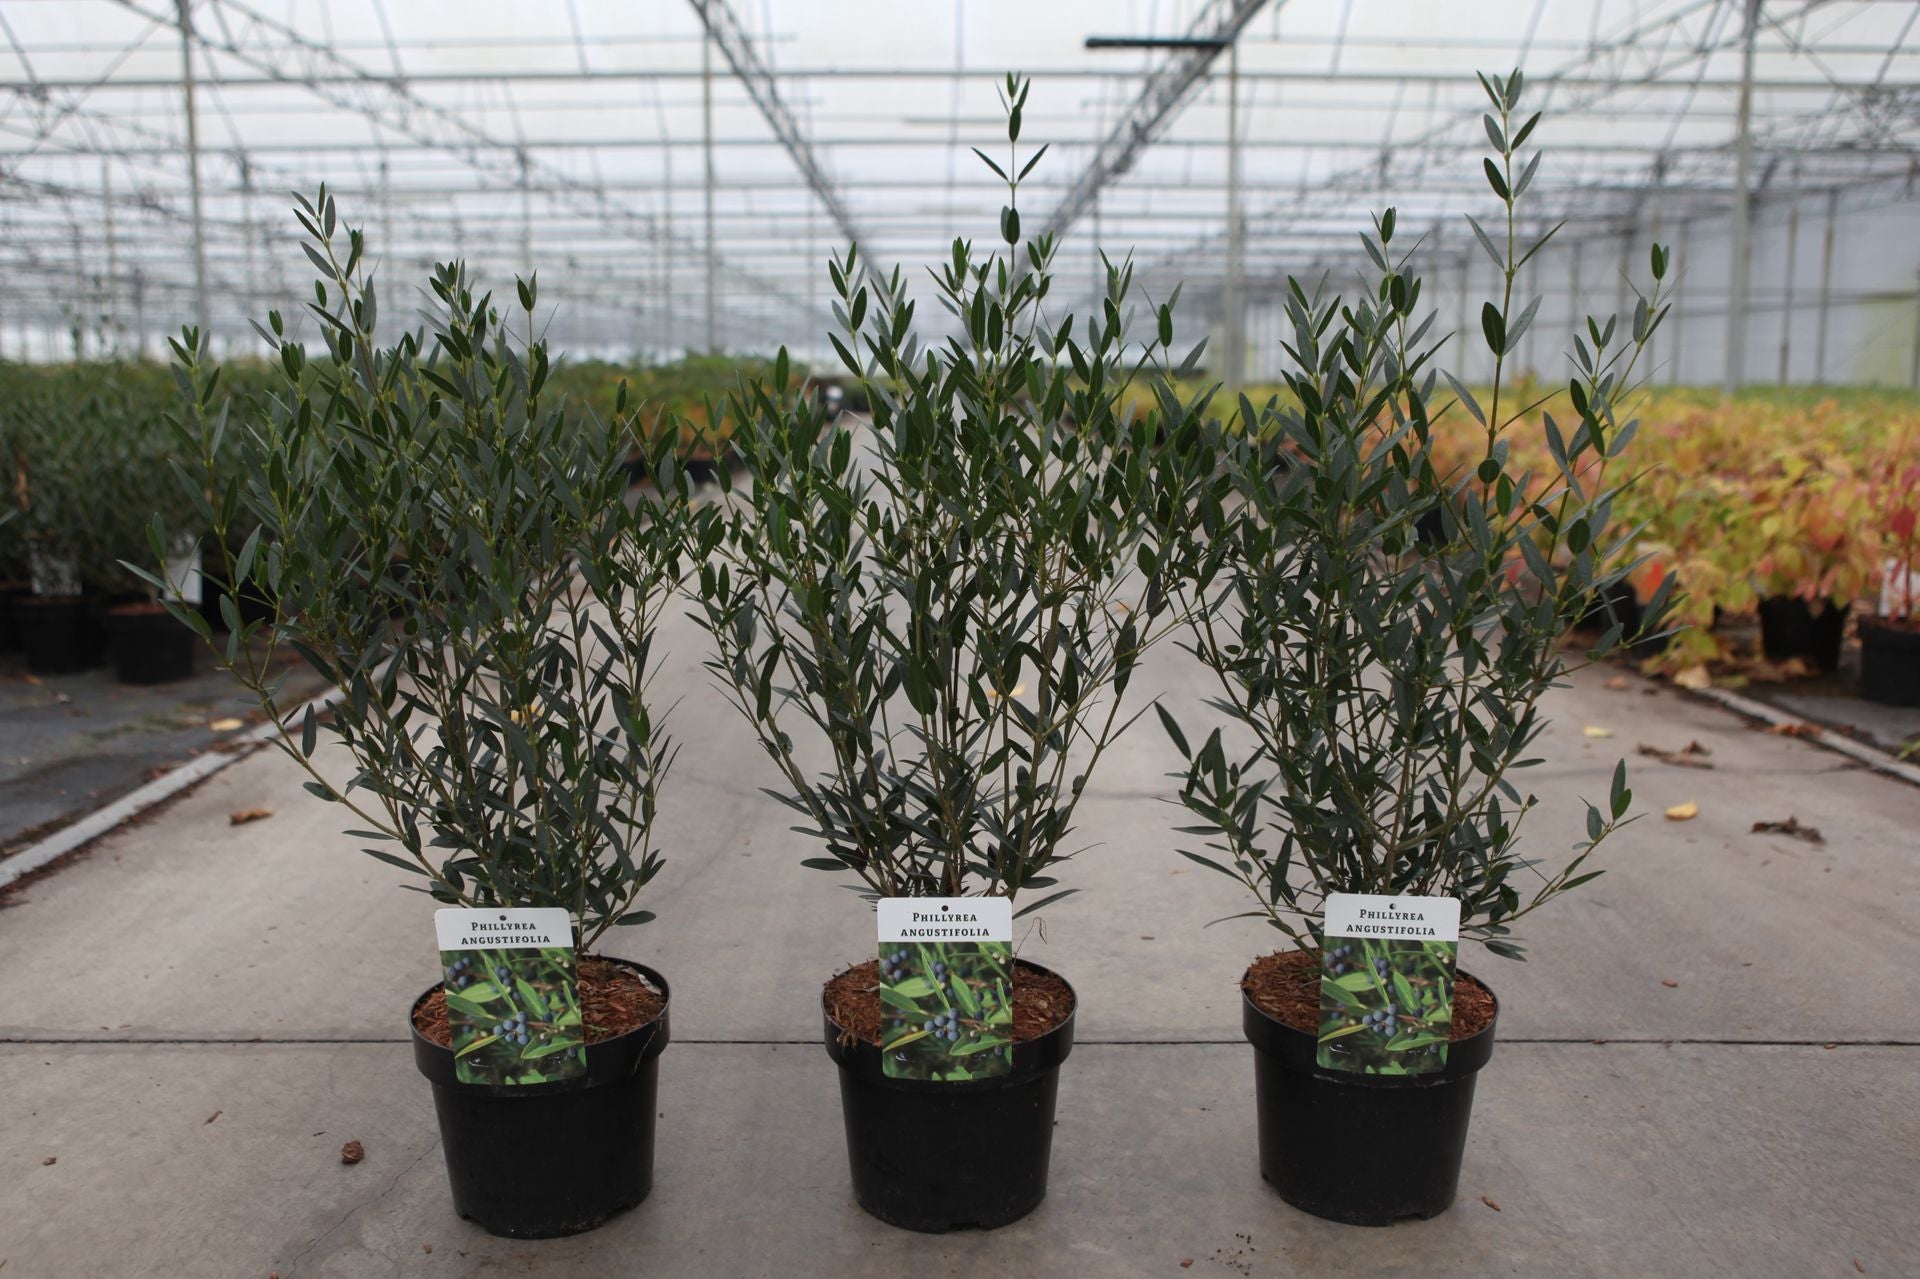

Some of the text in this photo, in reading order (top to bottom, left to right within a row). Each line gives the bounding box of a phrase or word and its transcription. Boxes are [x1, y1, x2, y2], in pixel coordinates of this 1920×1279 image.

[913, 912, 977, 922] PHILLYREA
[1360, 909, 1425, 921] PHILLYREA
[471, 922, 536, 931] PHILLYREA
[1346, 924, 1436, 936] ANGUSTIFOLIA
[901, 928, 990, 937] ANGUSTIFOLIA
[461, 935, 551, 945] ANGUSTIFOLIA
